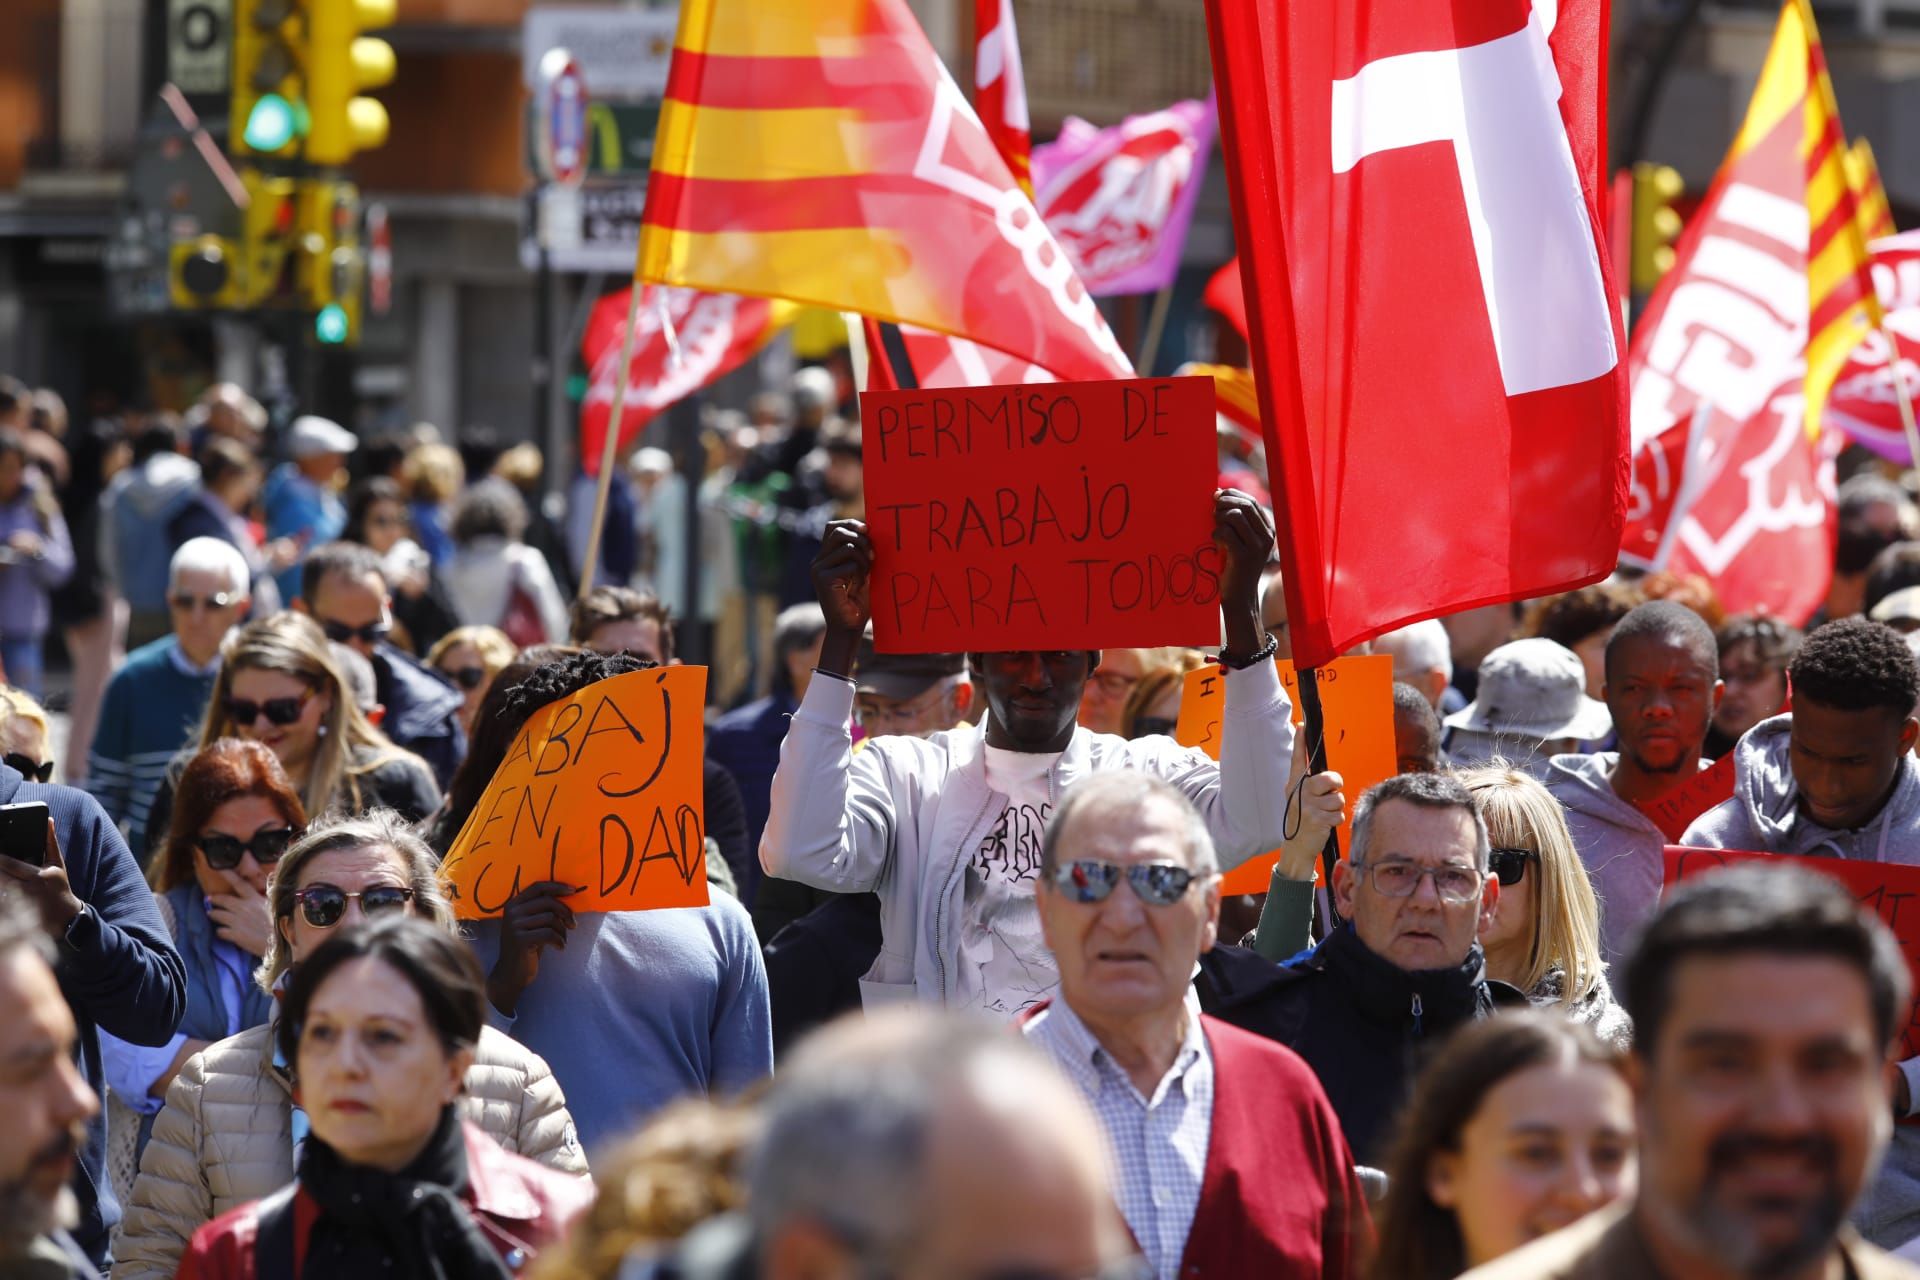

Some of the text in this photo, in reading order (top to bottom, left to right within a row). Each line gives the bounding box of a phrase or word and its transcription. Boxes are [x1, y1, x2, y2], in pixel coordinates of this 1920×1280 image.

[1123, 384, 1174, 442] DE
[890, 543, 1221, 635] PARA TODOS
